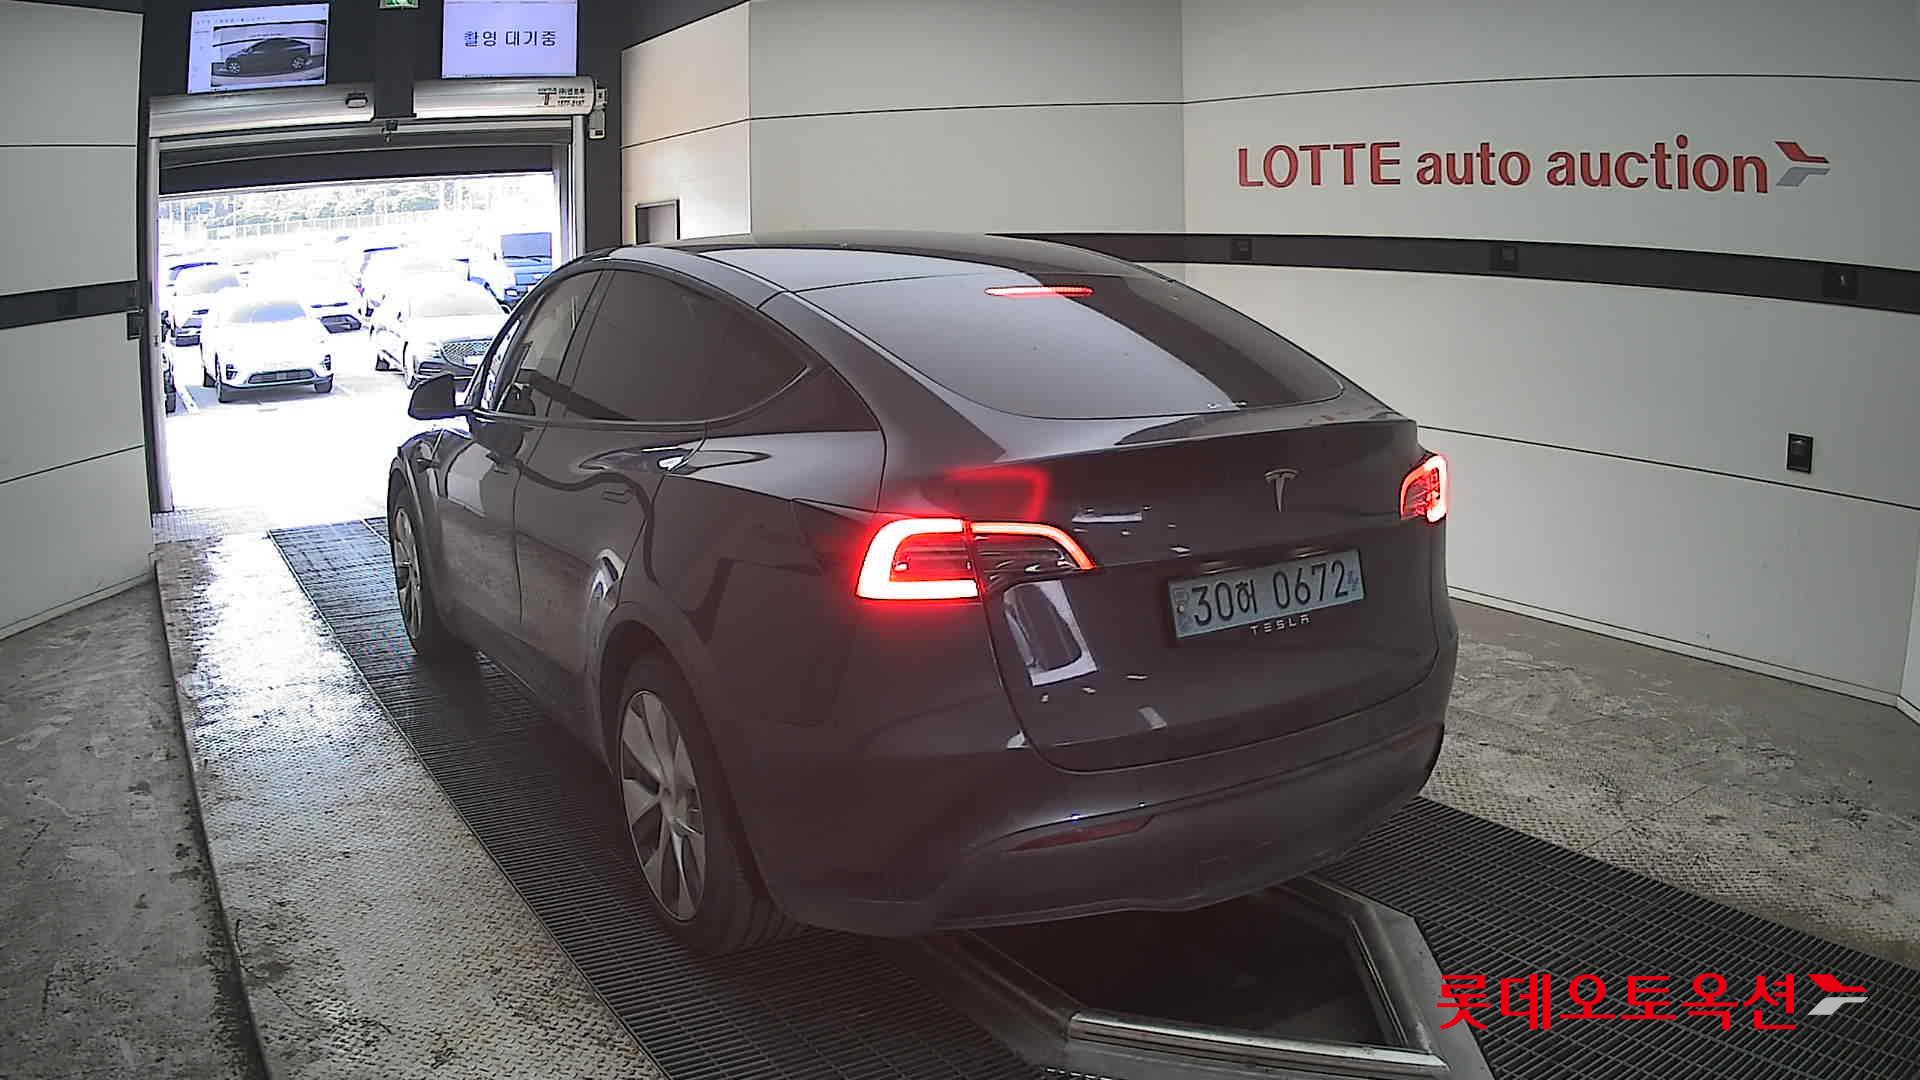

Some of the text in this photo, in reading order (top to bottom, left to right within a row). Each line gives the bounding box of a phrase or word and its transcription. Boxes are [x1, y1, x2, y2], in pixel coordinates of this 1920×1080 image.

[505, 30, 557, 47] 대기중
[1238, 135, 1768, 194] LOTTE auto auction
[1191, 559, 1348, 626] 30허 0672
[1250, 614, 1311, 636] TESLA
